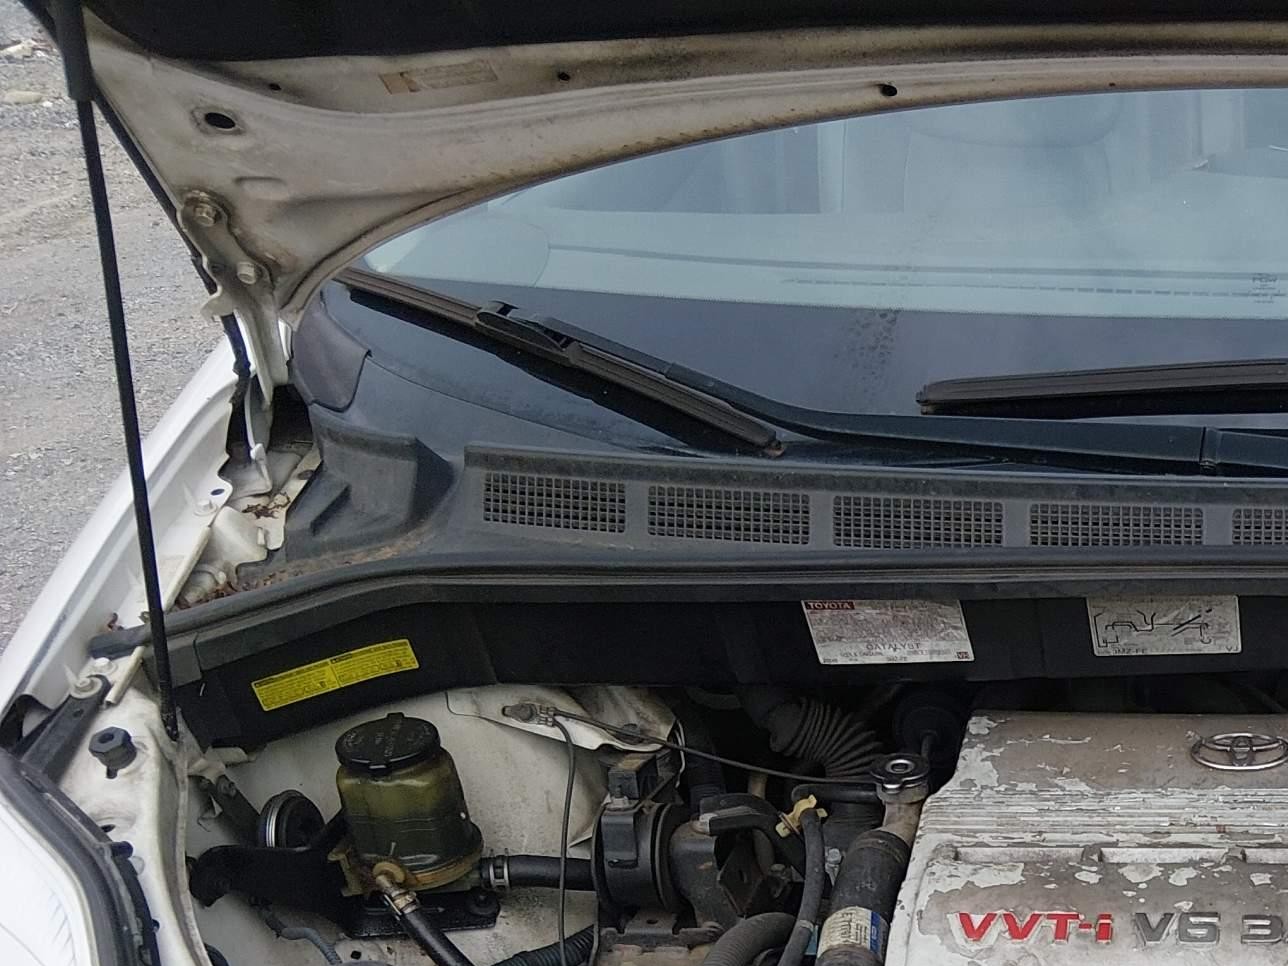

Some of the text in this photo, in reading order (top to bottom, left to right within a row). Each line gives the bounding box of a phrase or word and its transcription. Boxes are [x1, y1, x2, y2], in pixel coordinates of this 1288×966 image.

[808, 602, 851, 610] TOYOTA
[956, 911, 1114, 944] VVT-i
[1134, 911, 1221, 946] V6
